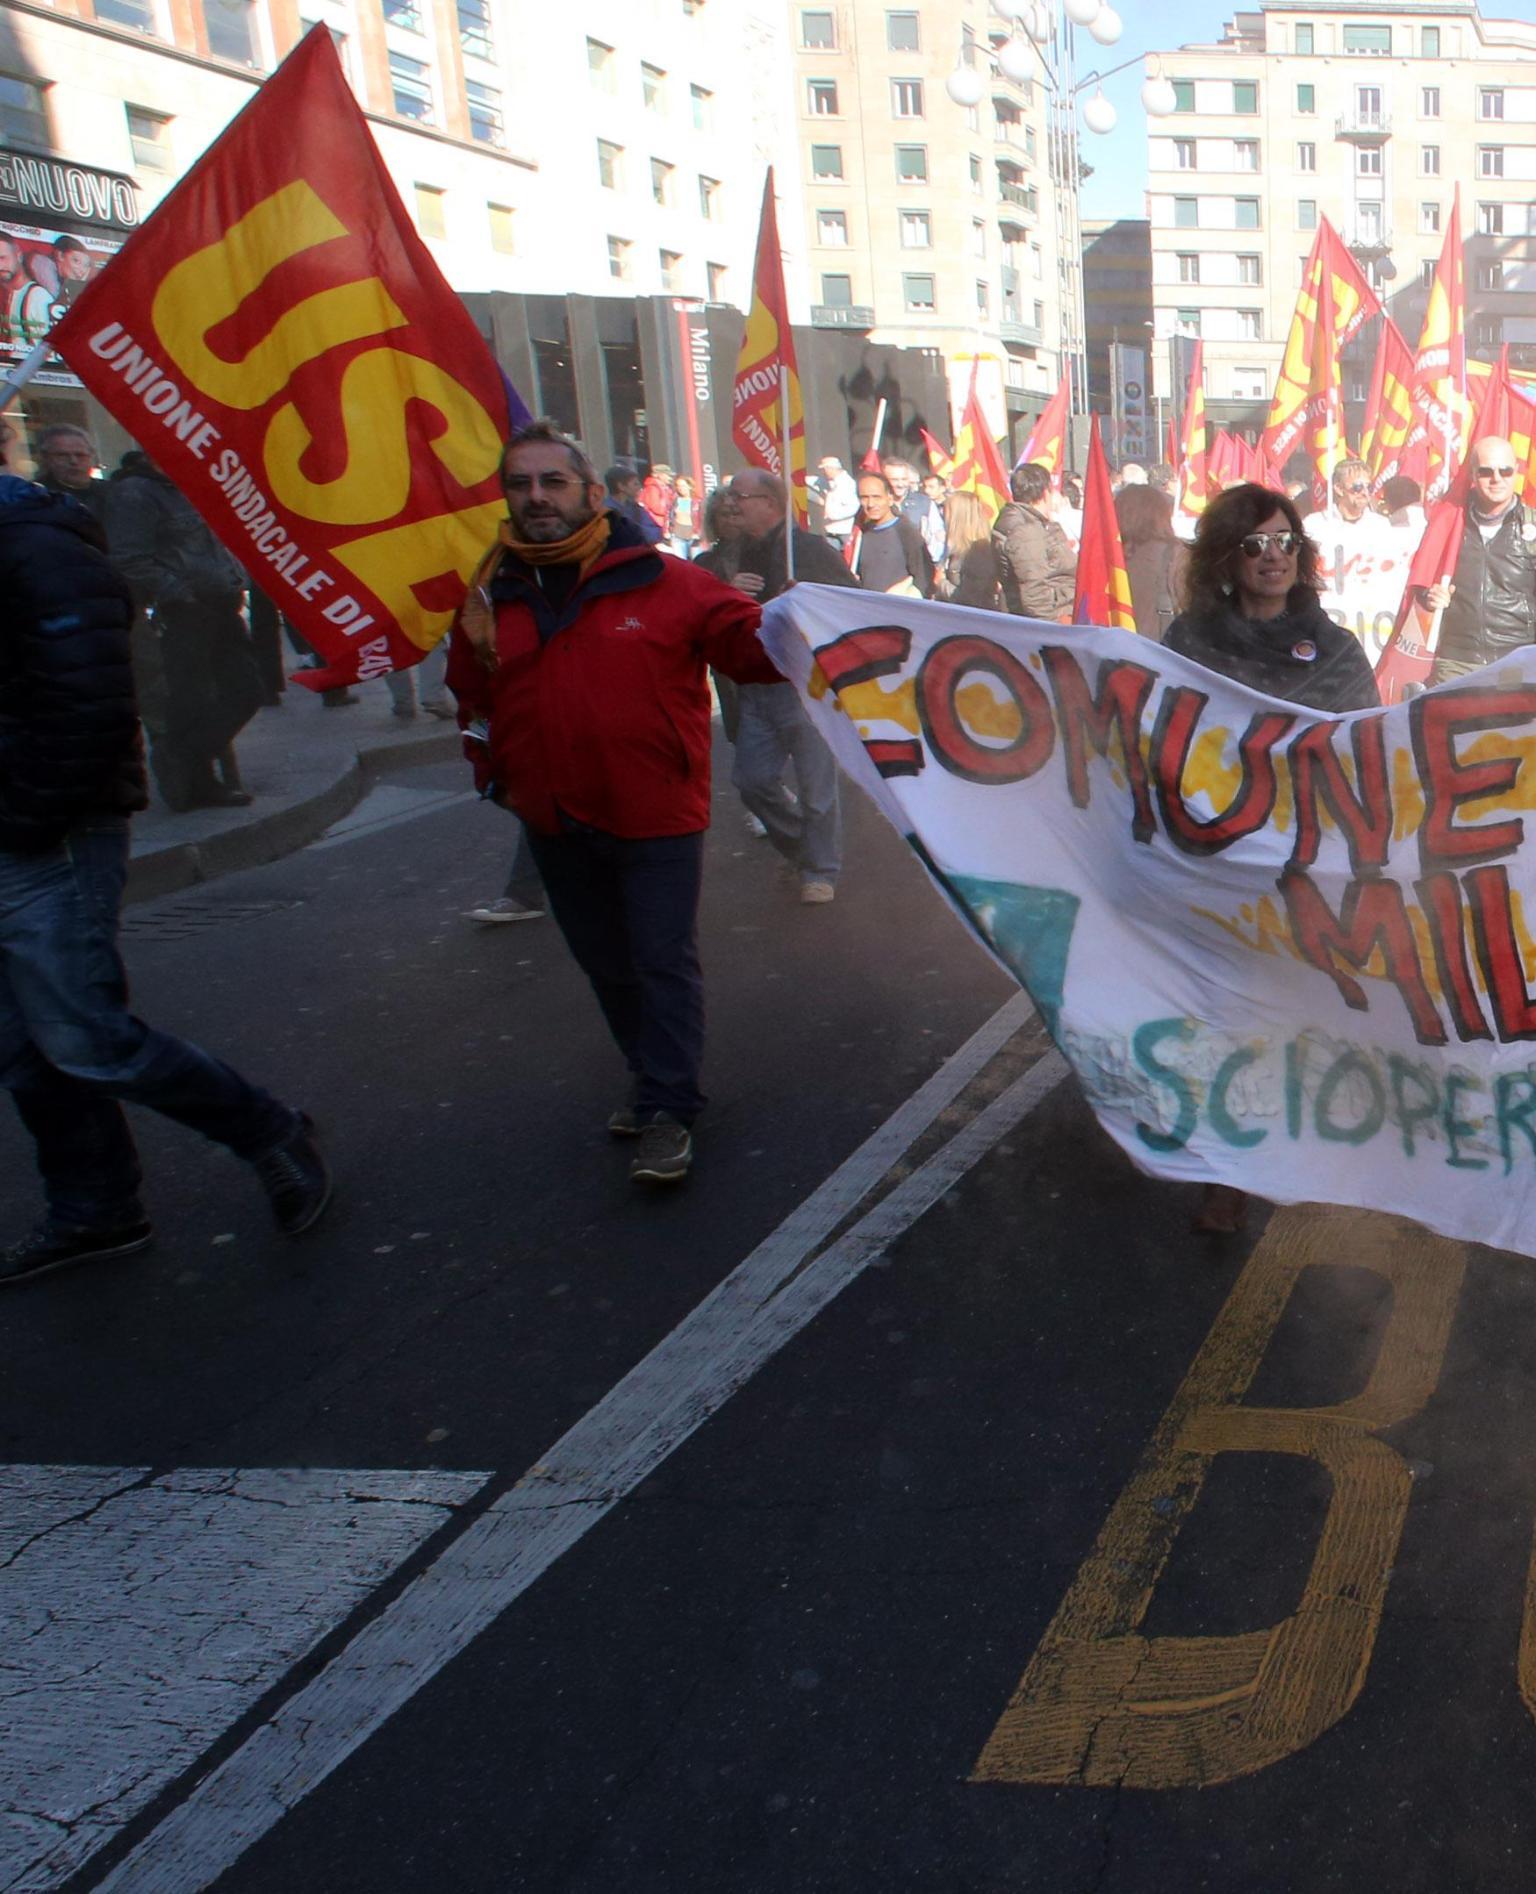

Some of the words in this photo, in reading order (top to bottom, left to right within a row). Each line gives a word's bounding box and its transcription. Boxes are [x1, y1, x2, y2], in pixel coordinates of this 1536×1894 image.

[12, 156, 137, 226] NUOVO
[690, 328, 711, 400] Milano
[88, 322, 222, 459] UNIONE
[208, 448, 336, 602] SINDACALE
[320, 595, 375, 636] DI
